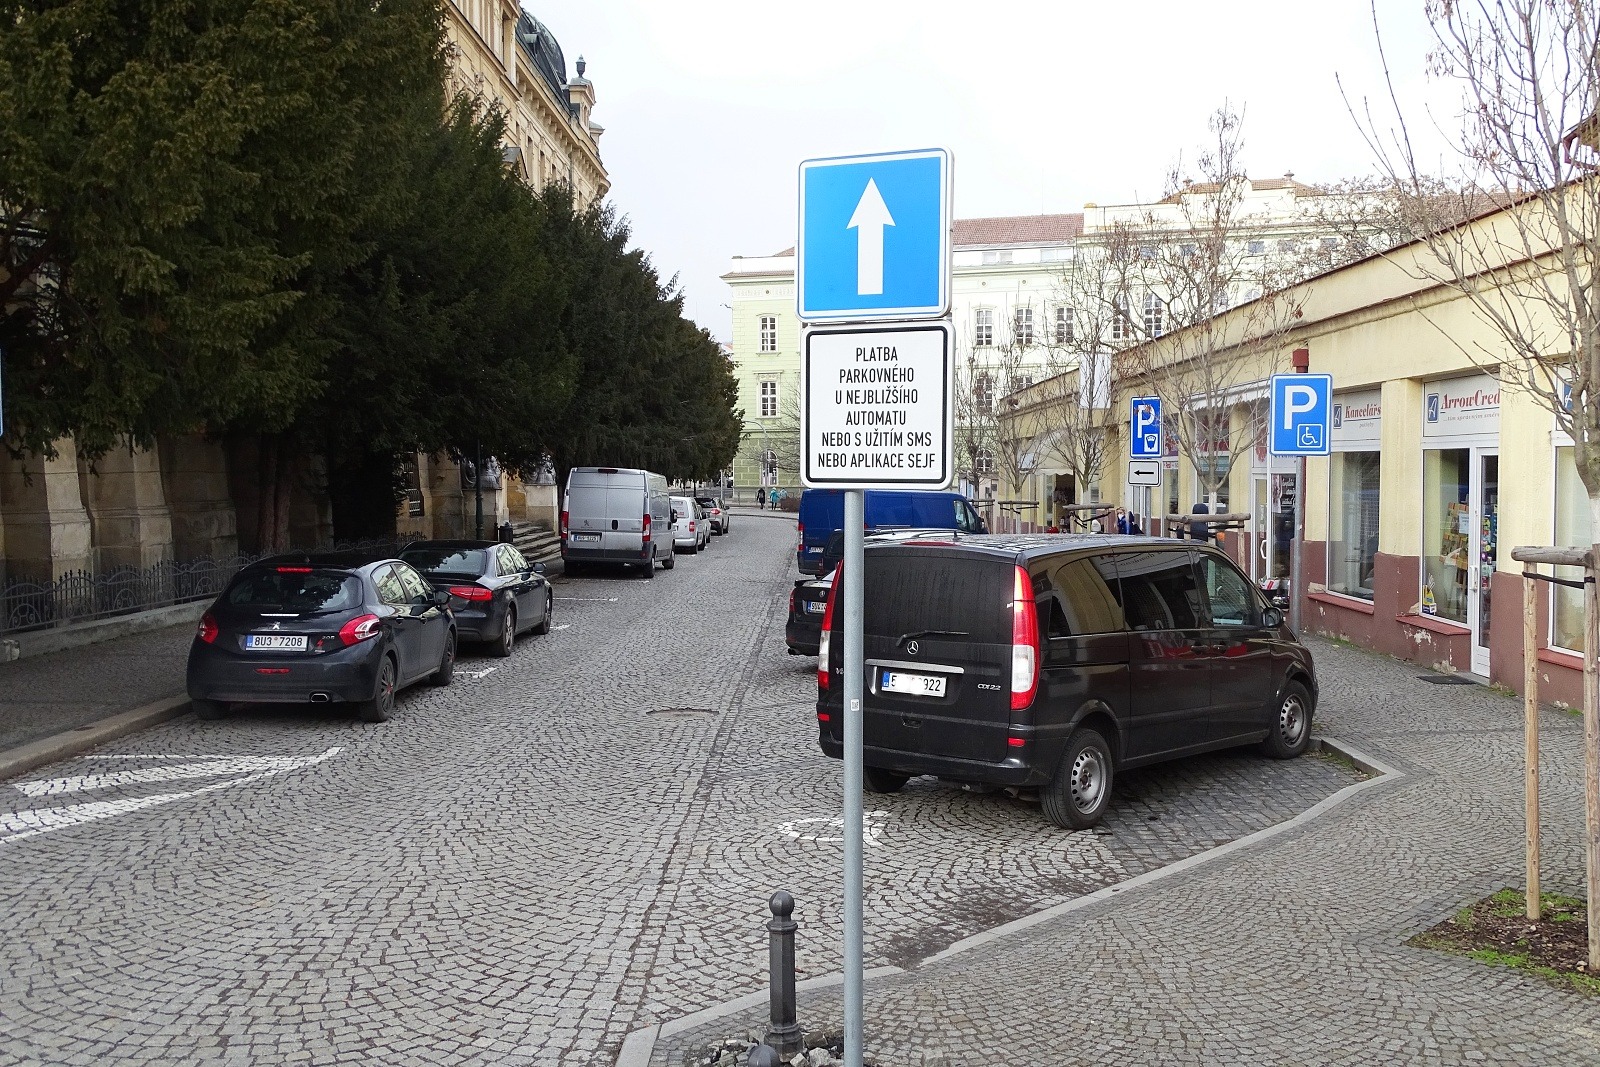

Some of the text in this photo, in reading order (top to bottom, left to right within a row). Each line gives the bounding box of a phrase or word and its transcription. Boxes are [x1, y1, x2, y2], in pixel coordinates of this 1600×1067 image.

[856, 346, 898, 362] PLATBA
[839, 364, 914, 384] PARKOVNÉHO
[835, 385, 918, 405] U NEJBLIŽŠÍHO
[1284, 385, 1317, 430] P
[845, 410, 906, 426] AUTOMATU
[1137, 404, 1155, 439] P
[821, 428, 932, 447] NEBO S UŽITÍM SMS
[818, 452, 936, 469] NEBO APLIKACE SEJF
[254, 637, 272, 646] 8U3
[279, 637, 303, 647] 7208
